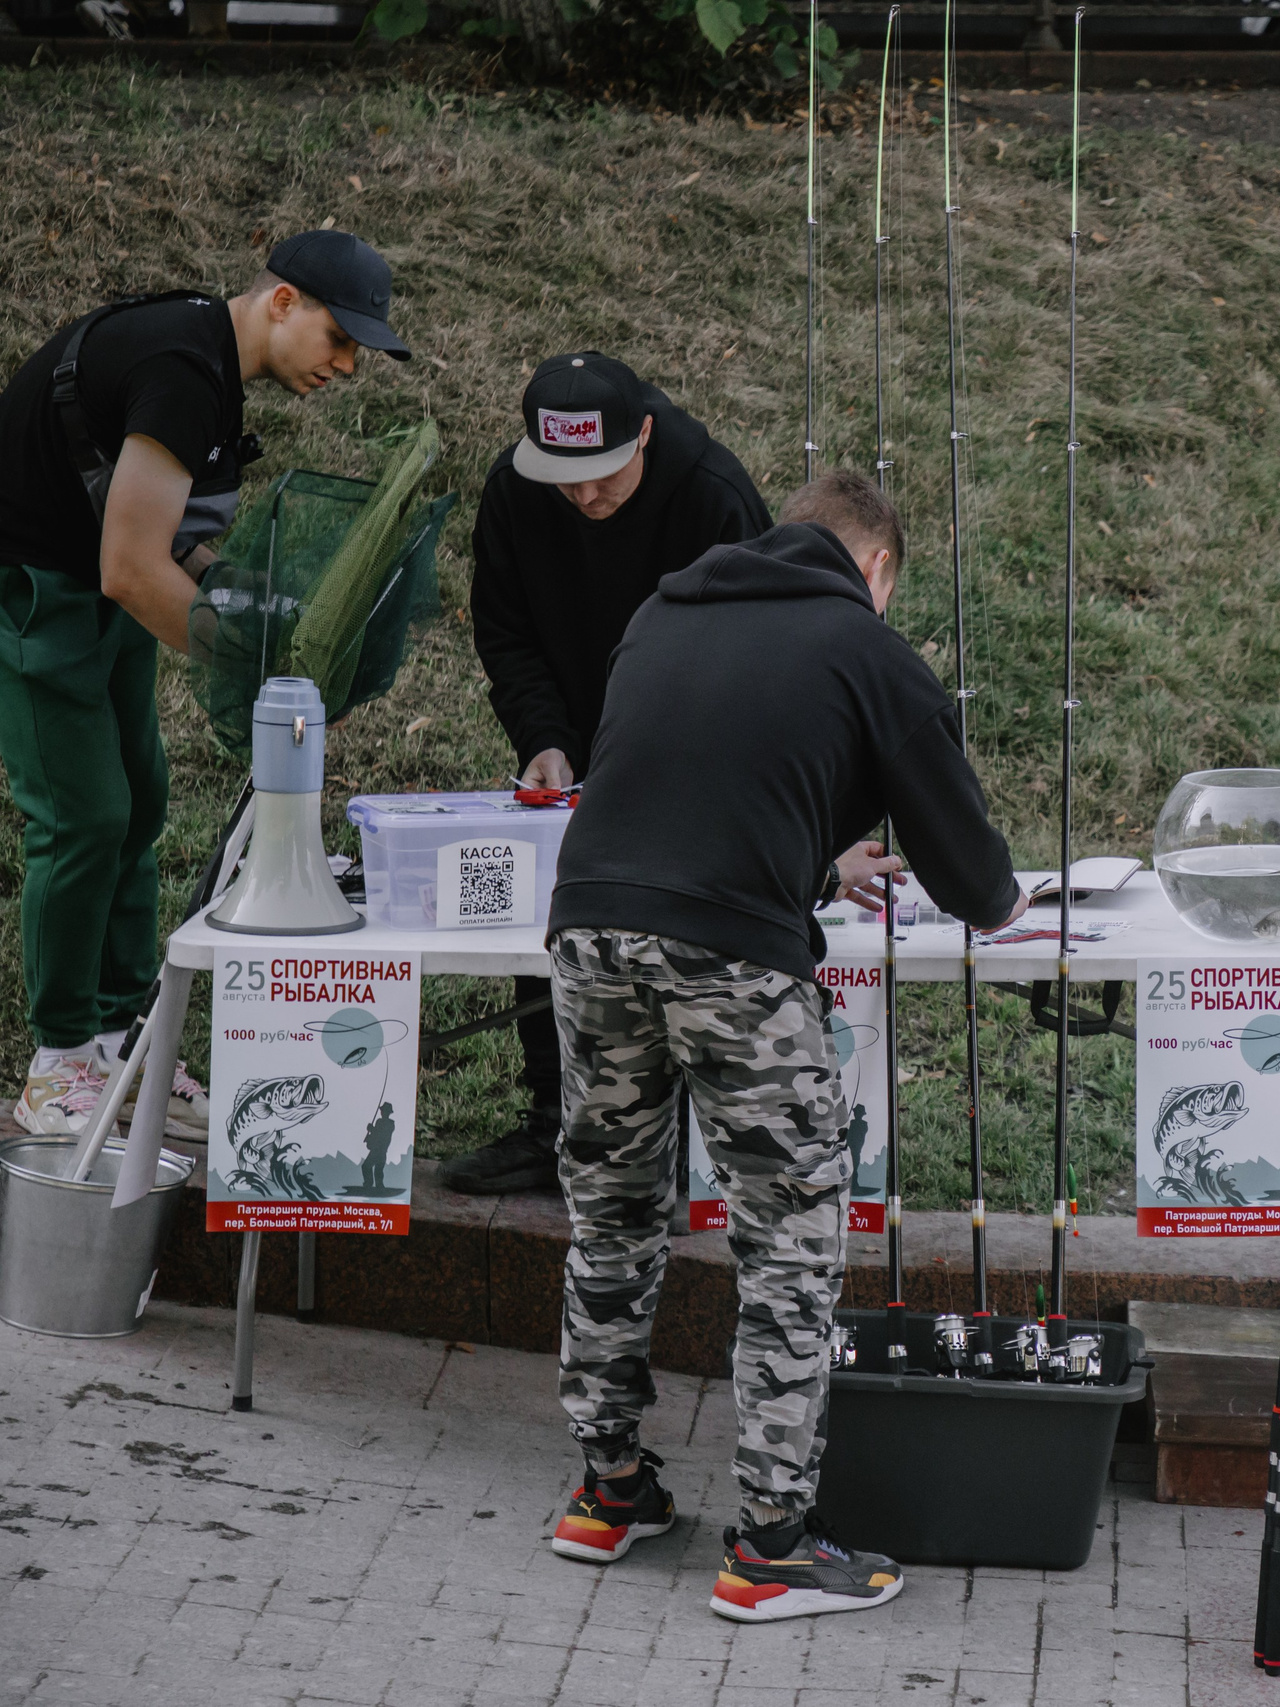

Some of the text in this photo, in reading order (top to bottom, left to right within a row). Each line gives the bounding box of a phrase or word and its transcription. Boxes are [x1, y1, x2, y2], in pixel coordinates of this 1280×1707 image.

[460, 845, 514, 860] КАССА
[459, 916, 513, 926] ОПЛАТИ ОНЛАЙН
[224, 960, 266, 991] 25
[270, 959, 412, 982] СПОРТИВНАЯ
[813, 967, 881, 987] ИВНАЯ
[1147, 970, 1186, 1001] 25
[222, 992, 266, 1004] августа
[270, 982, 376, 1004] РЫБАЛКА
[1145, 1001, 1187, 1013] августа
[223, 1029, 315, 1045] 1000 руб/час
[1147, 1038, 1234, 1052] 1000 руб/час
[237, 1204, 383, 1218] Патриаршие пруды. Москва,
[1165, 1210, 1228, 1222] Патриаршие
[1230, 1211, 1264, 1223] пруды.
[224, 1217, 393, 1231] пер. Большой Патриарший, д. 7/1
[707, 1217, 727, 1227] пер.
[856, 1217, 868, 1229] 7/1
[1154, 1225, 1175, 1235] пер.
[1177, 1223, 1222, 1234] Большой
